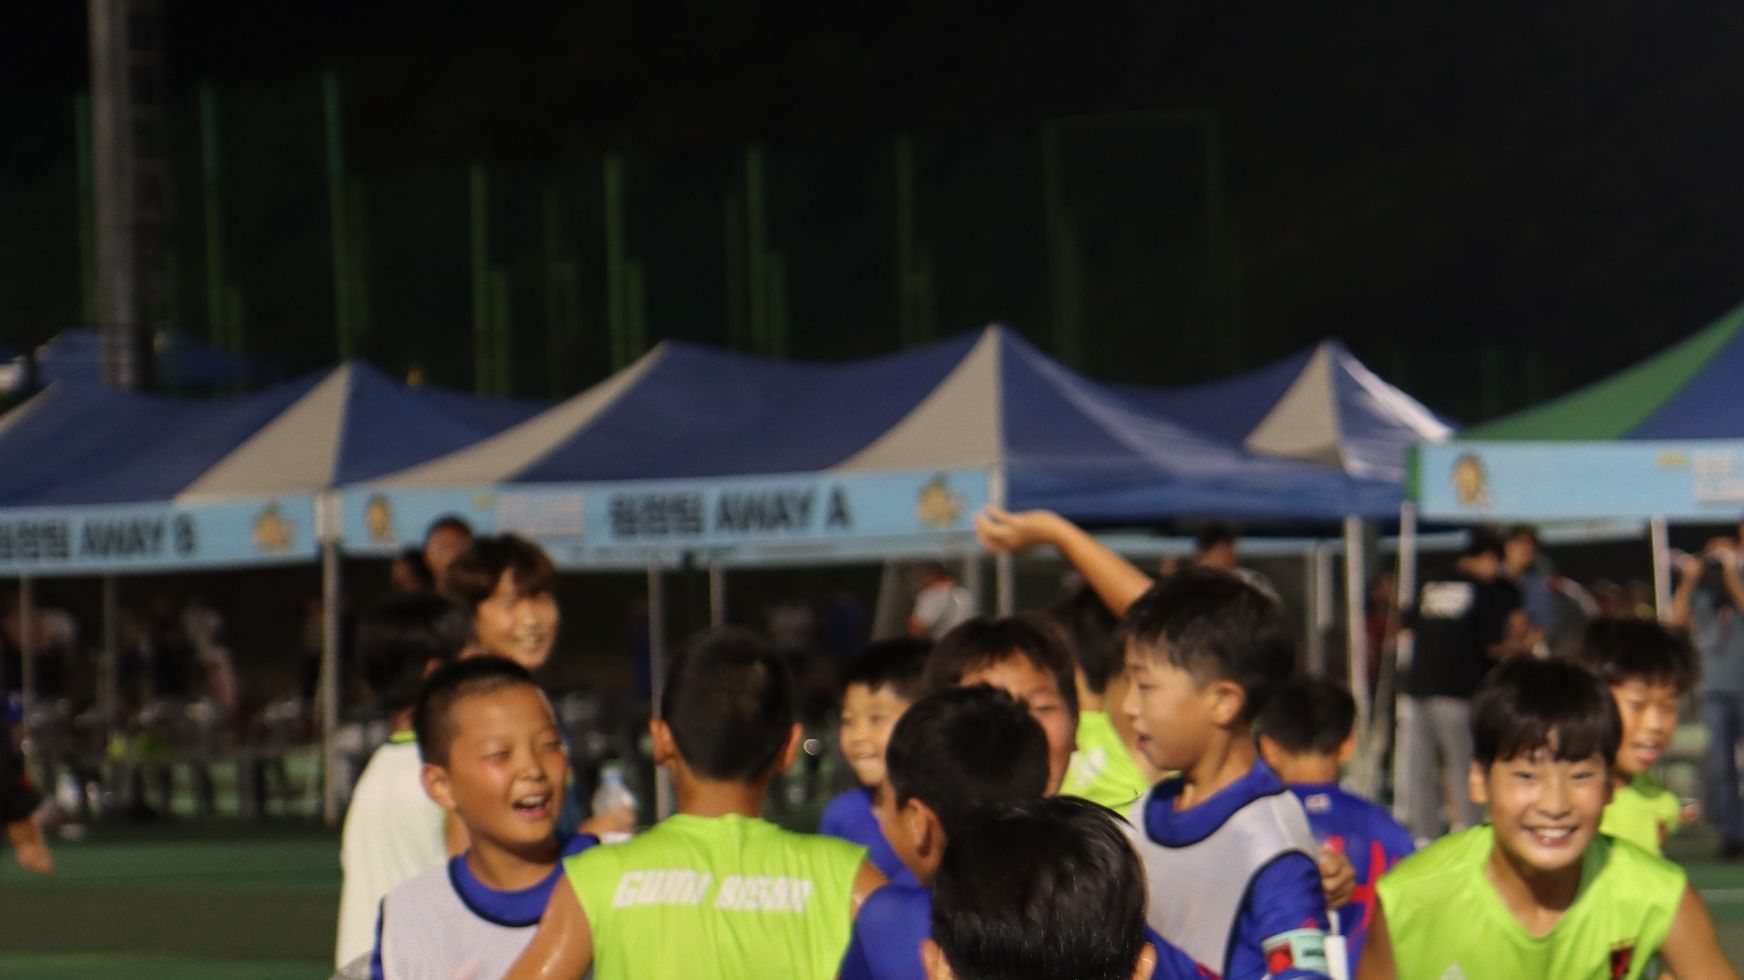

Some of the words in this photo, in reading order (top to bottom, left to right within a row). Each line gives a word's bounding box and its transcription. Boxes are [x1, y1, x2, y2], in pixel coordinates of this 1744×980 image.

[715, 489, 817, 533] AWAY
[824, 485, 852, 529] A
[80, 514, 162, 558] AWAY
